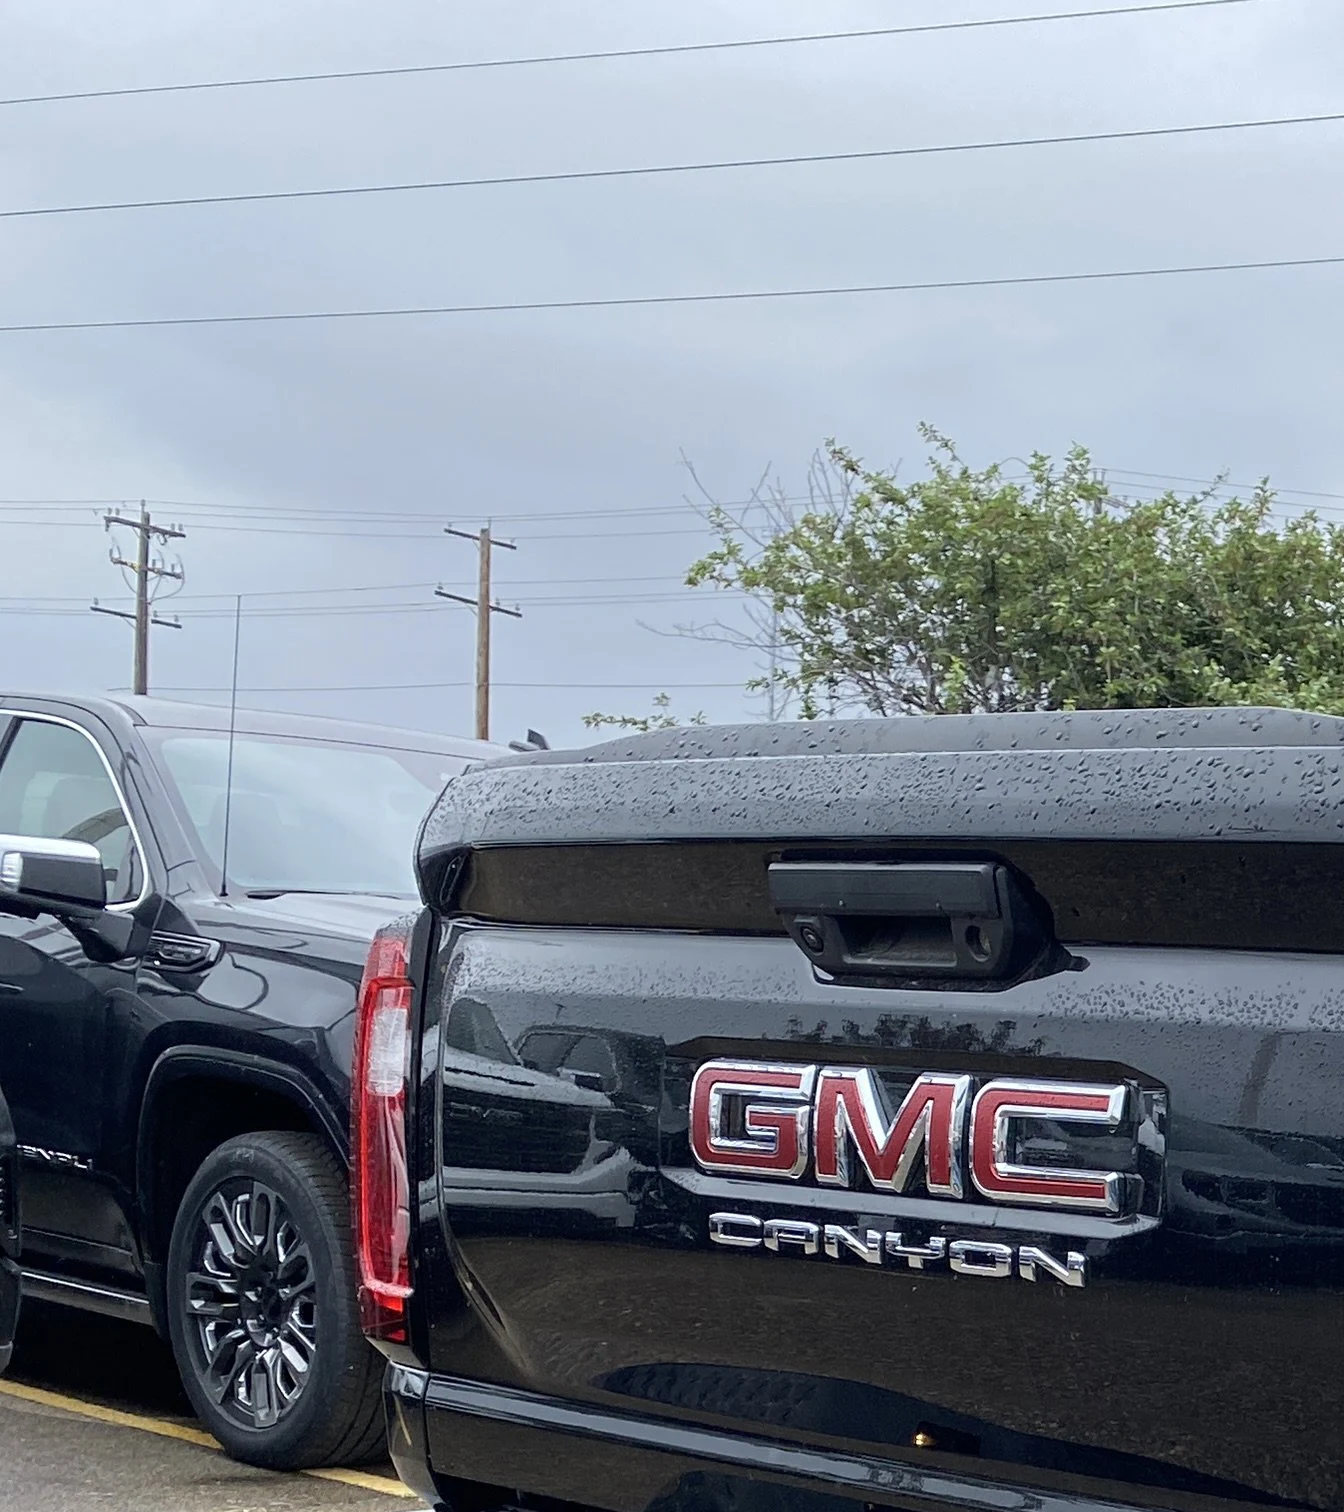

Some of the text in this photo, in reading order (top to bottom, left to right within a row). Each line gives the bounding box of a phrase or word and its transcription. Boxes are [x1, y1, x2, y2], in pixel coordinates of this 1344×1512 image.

[16, 1144, 93, 1171] ENALI
[690, 1059, 1134, 1214] GMC
[708, 1211, 1088, 1288] CANYON
